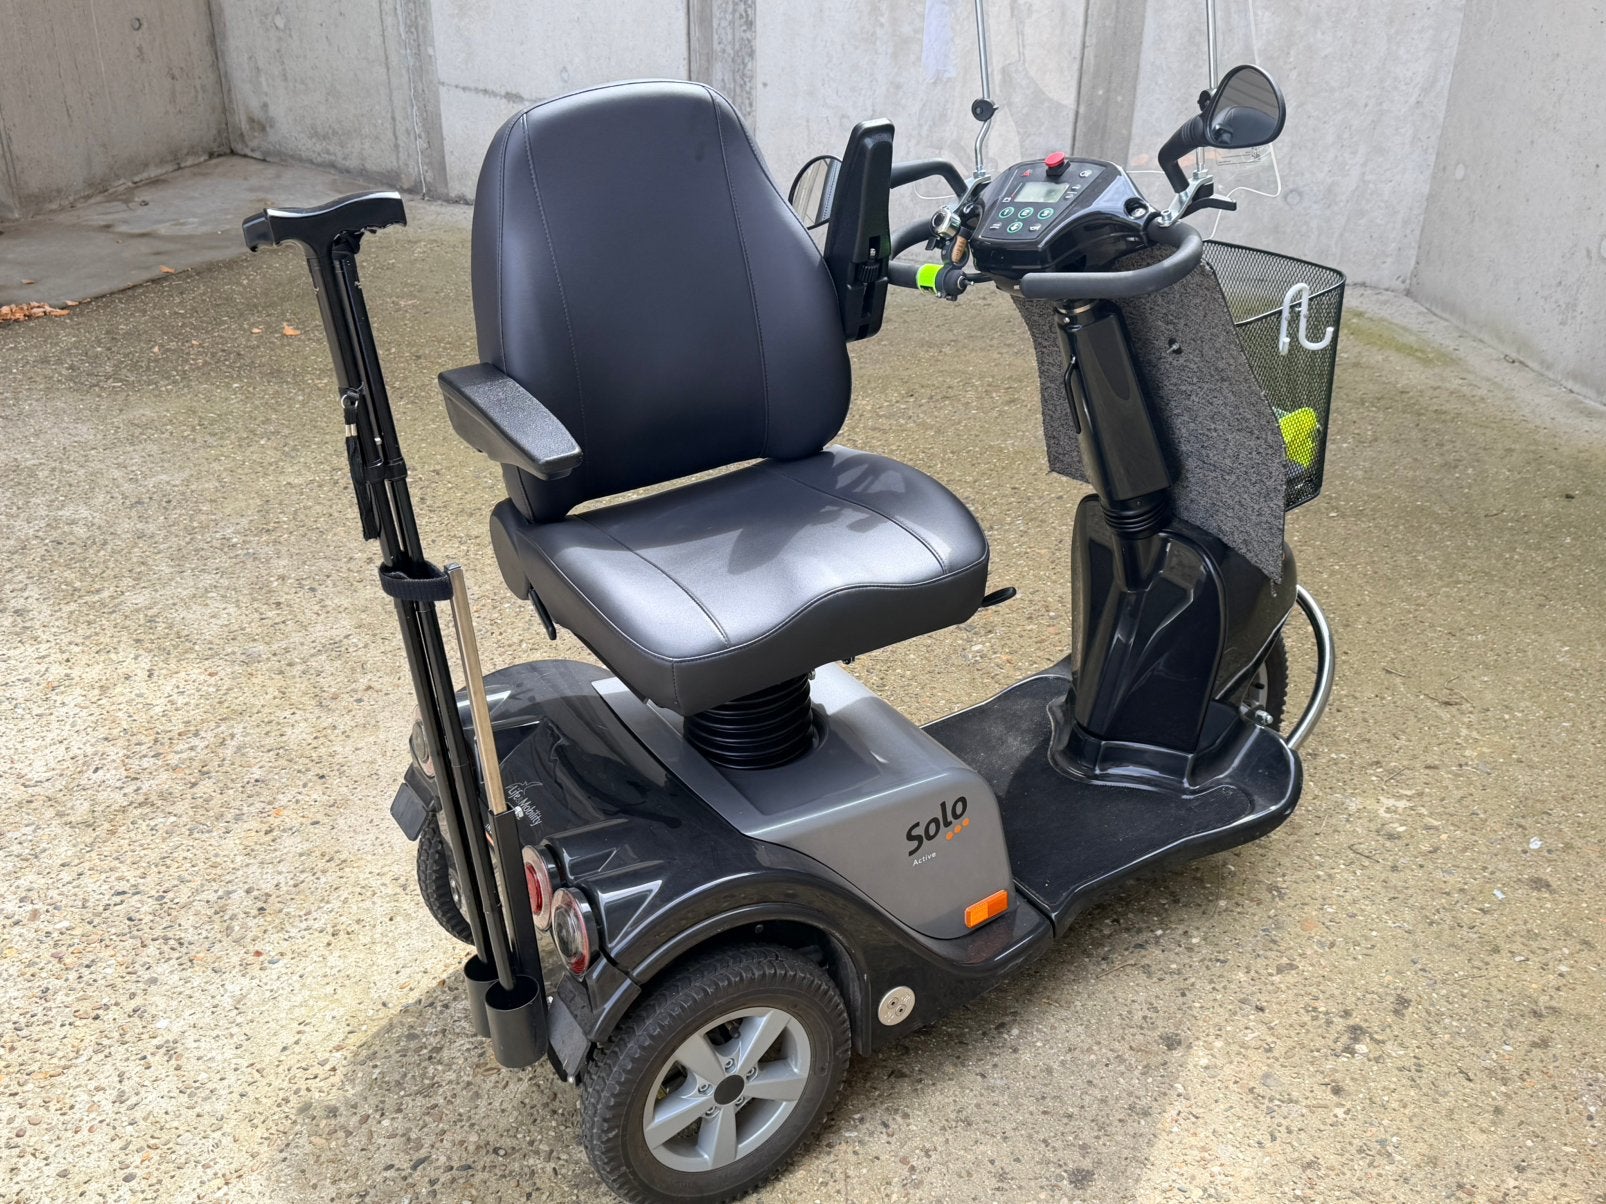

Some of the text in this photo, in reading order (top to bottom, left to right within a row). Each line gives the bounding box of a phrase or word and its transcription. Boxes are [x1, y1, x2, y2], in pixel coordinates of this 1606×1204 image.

[508, 785, 524, 800] Life
[519, 797, 543, 826] Mobility
[905, 796, 968, 857] Solo
[913, 852, 937, 866] Active
